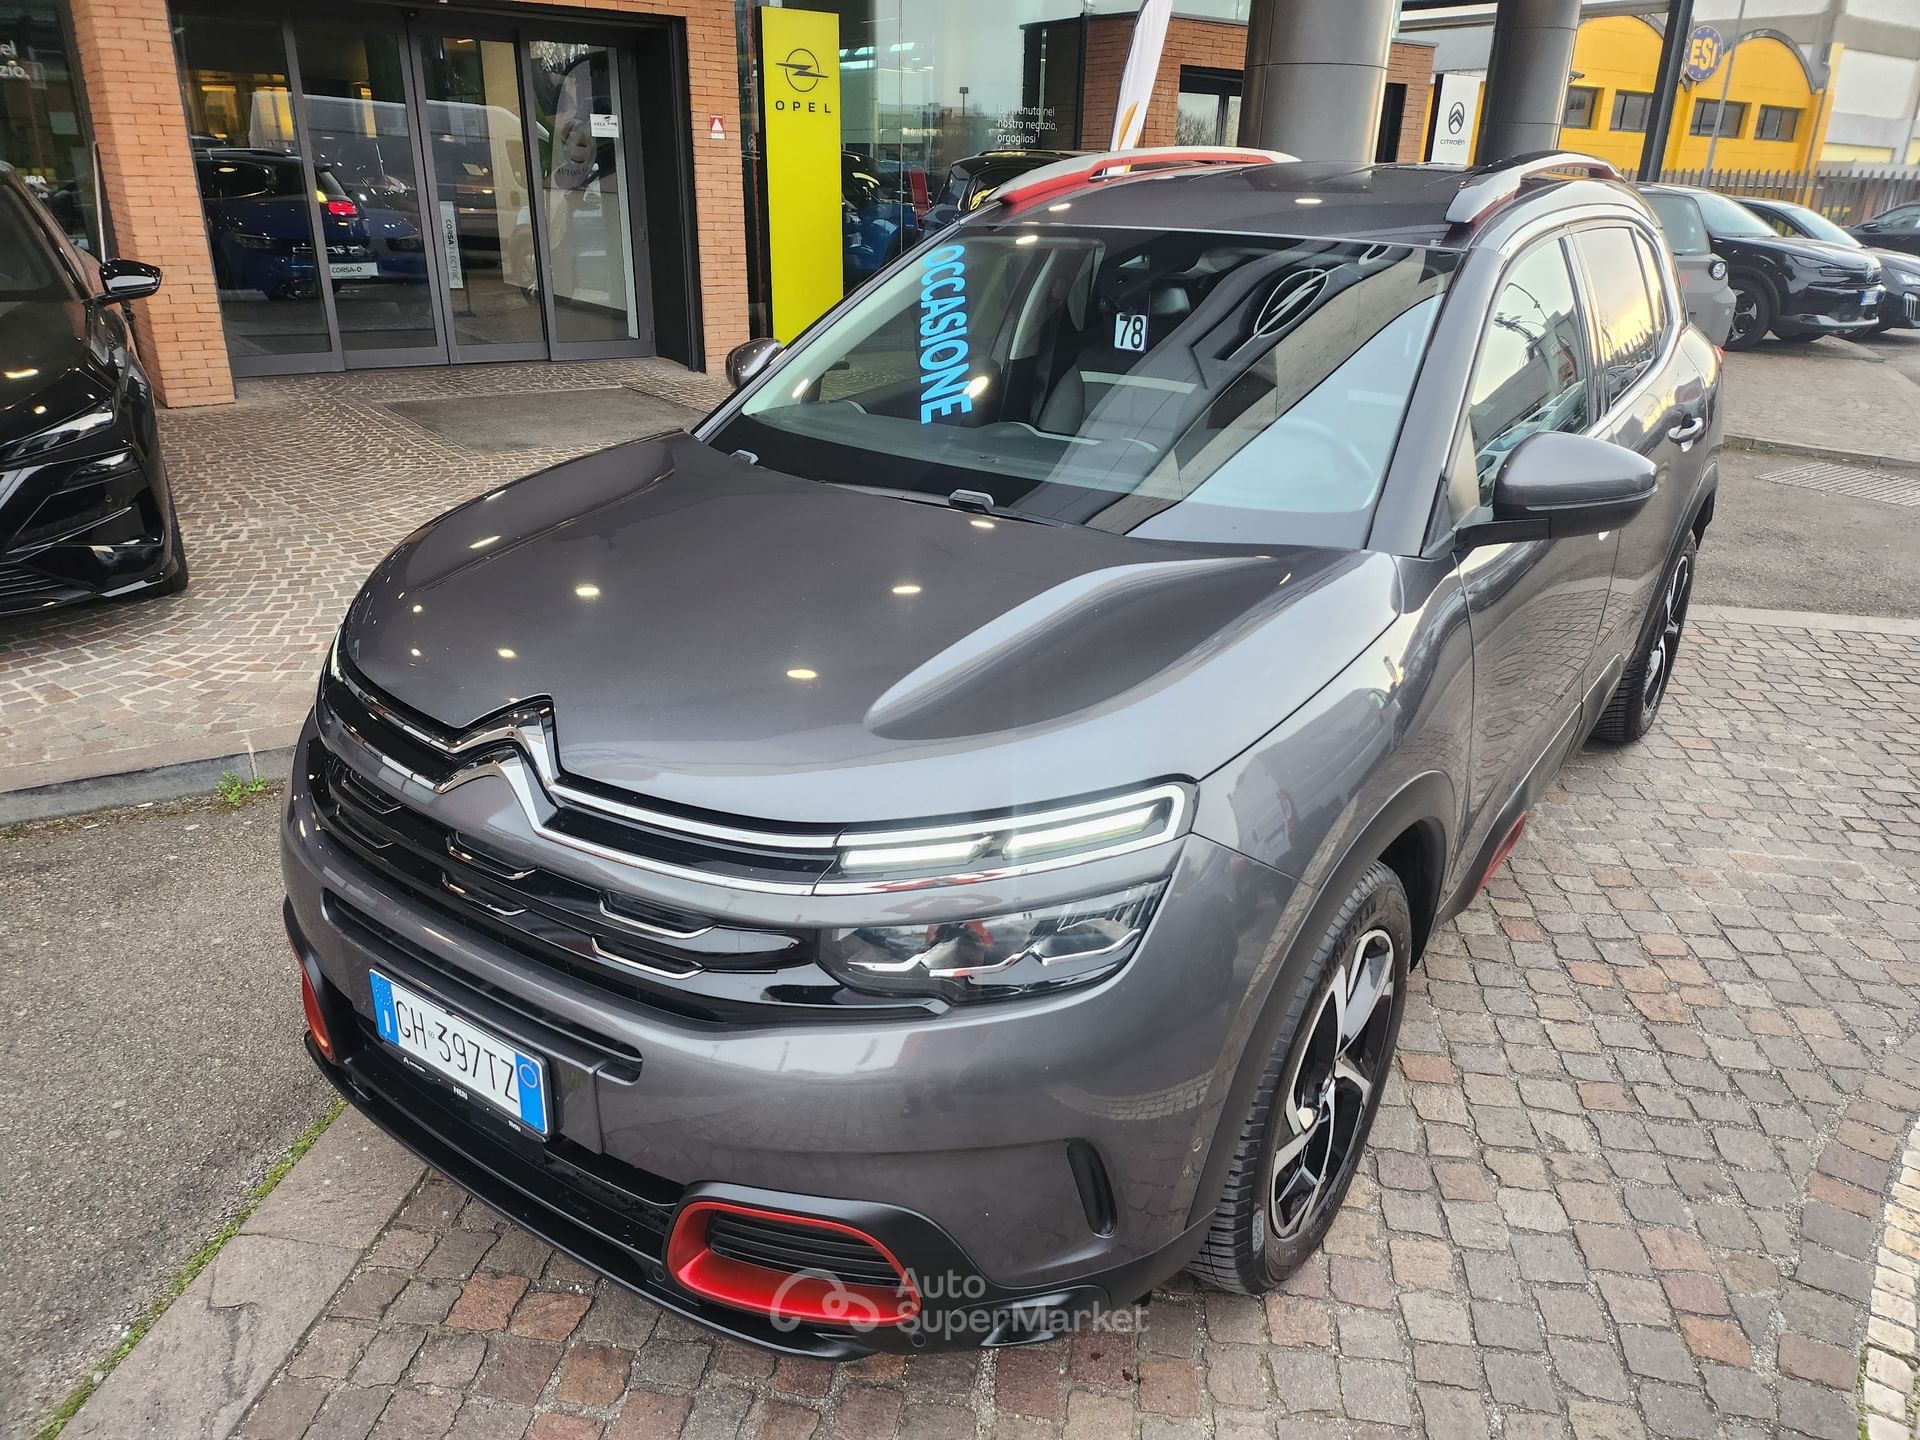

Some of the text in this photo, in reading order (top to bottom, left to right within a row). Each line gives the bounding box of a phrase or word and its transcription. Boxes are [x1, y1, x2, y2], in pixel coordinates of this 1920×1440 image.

[1689, 37, 1719, 71] ESI
[775, 100, 832, 114] OPEL
[997, 119, 1024, 130] nostro
[997, 133, 1036, 145] orgogliosi
[919, 244, 973, 425] OCCASIONE
[1119, 316, 1144, 350] 78
[395, 1000, 428, 1051] GH
[434, 1020, 519, 1104] 397TZ
